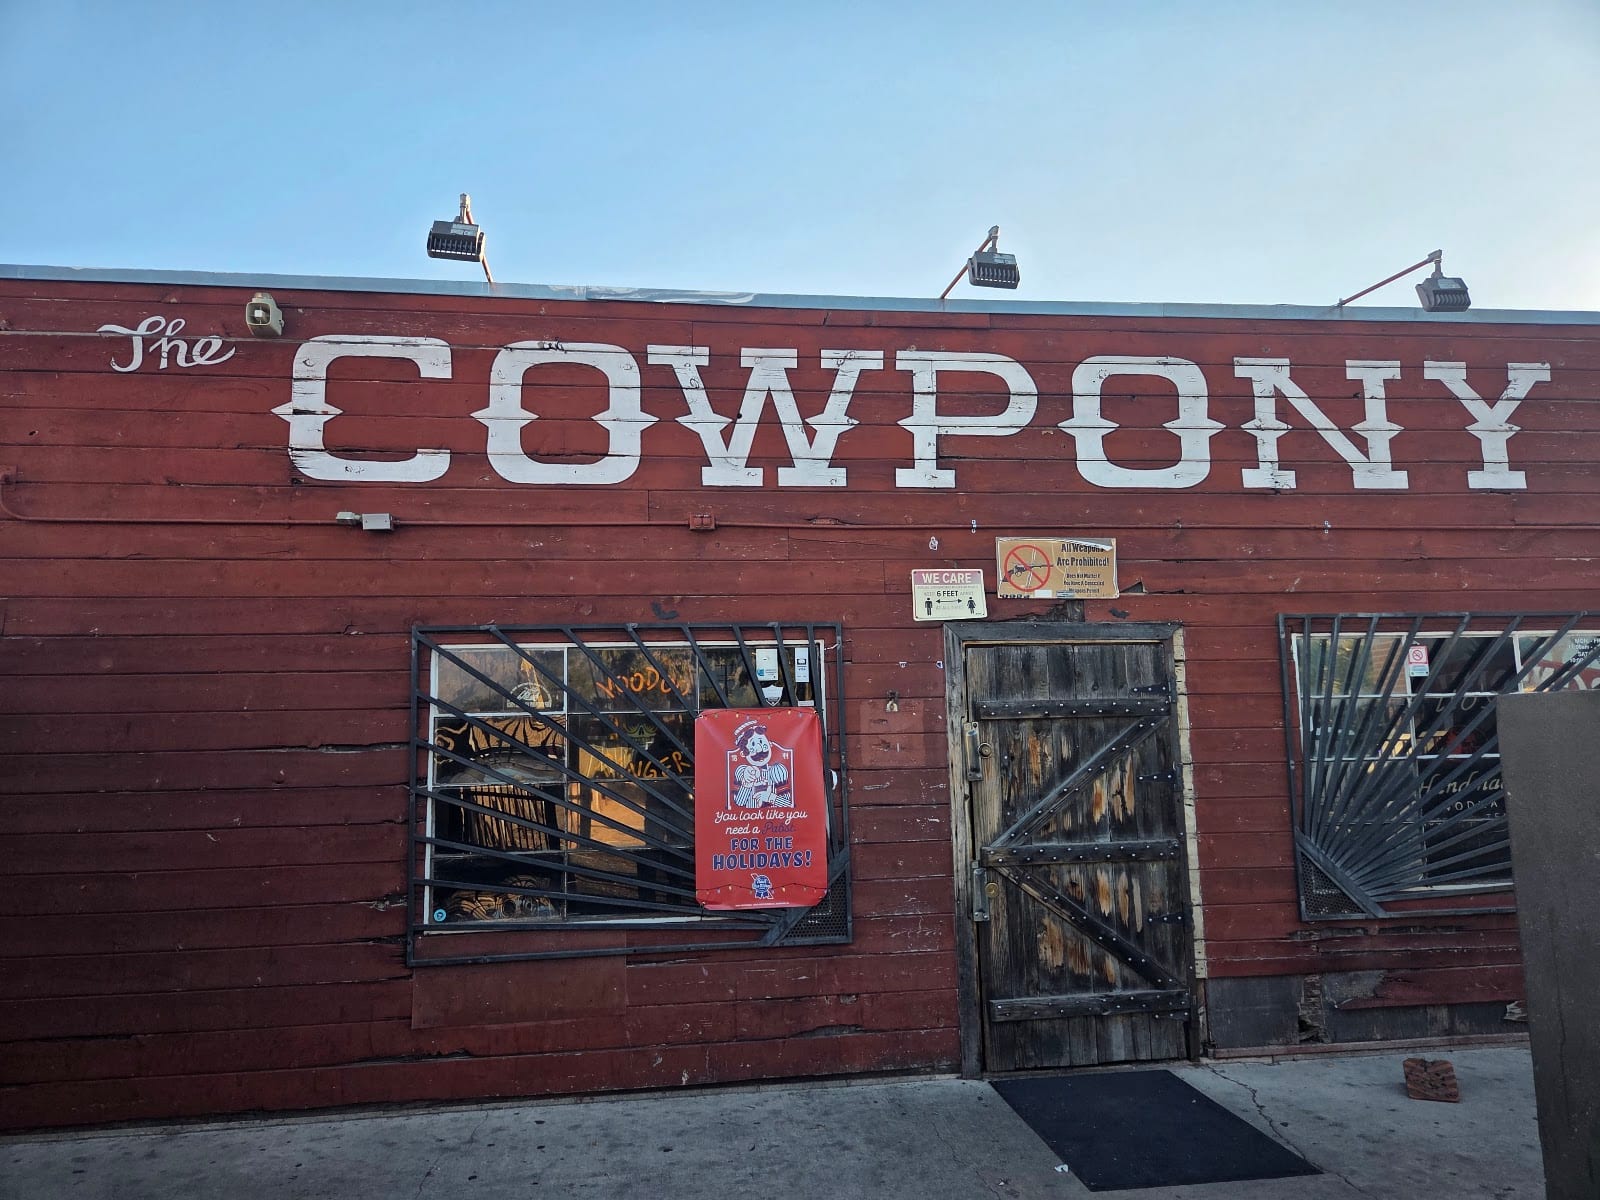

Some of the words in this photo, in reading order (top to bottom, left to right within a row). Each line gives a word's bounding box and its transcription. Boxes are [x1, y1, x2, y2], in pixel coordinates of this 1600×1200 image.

[96, 316, 236, 373] The
[270, 333, 1552, 492] COWPONY
[1061, 543, 1071, 552] All
[1057, 557, 1069, 566] Are
[1070, 556, 1109, 566] Prohibited!
[921, 572, 940, 584] WE
[942, 572, 972, 584] CARE
[714, 810, 737, 824] You
[739, 808, 764, 820] look
[766, 808, 785, 820] like
[784, 810, 808, 825] you
[725, 824, 750, 835] need
[752, 826, 760, 834] a
[731, 837, 759, 851] FOR
[764, 836, 794, 850] THE
[712, 849, 812, 871] HOLIDAYS!
